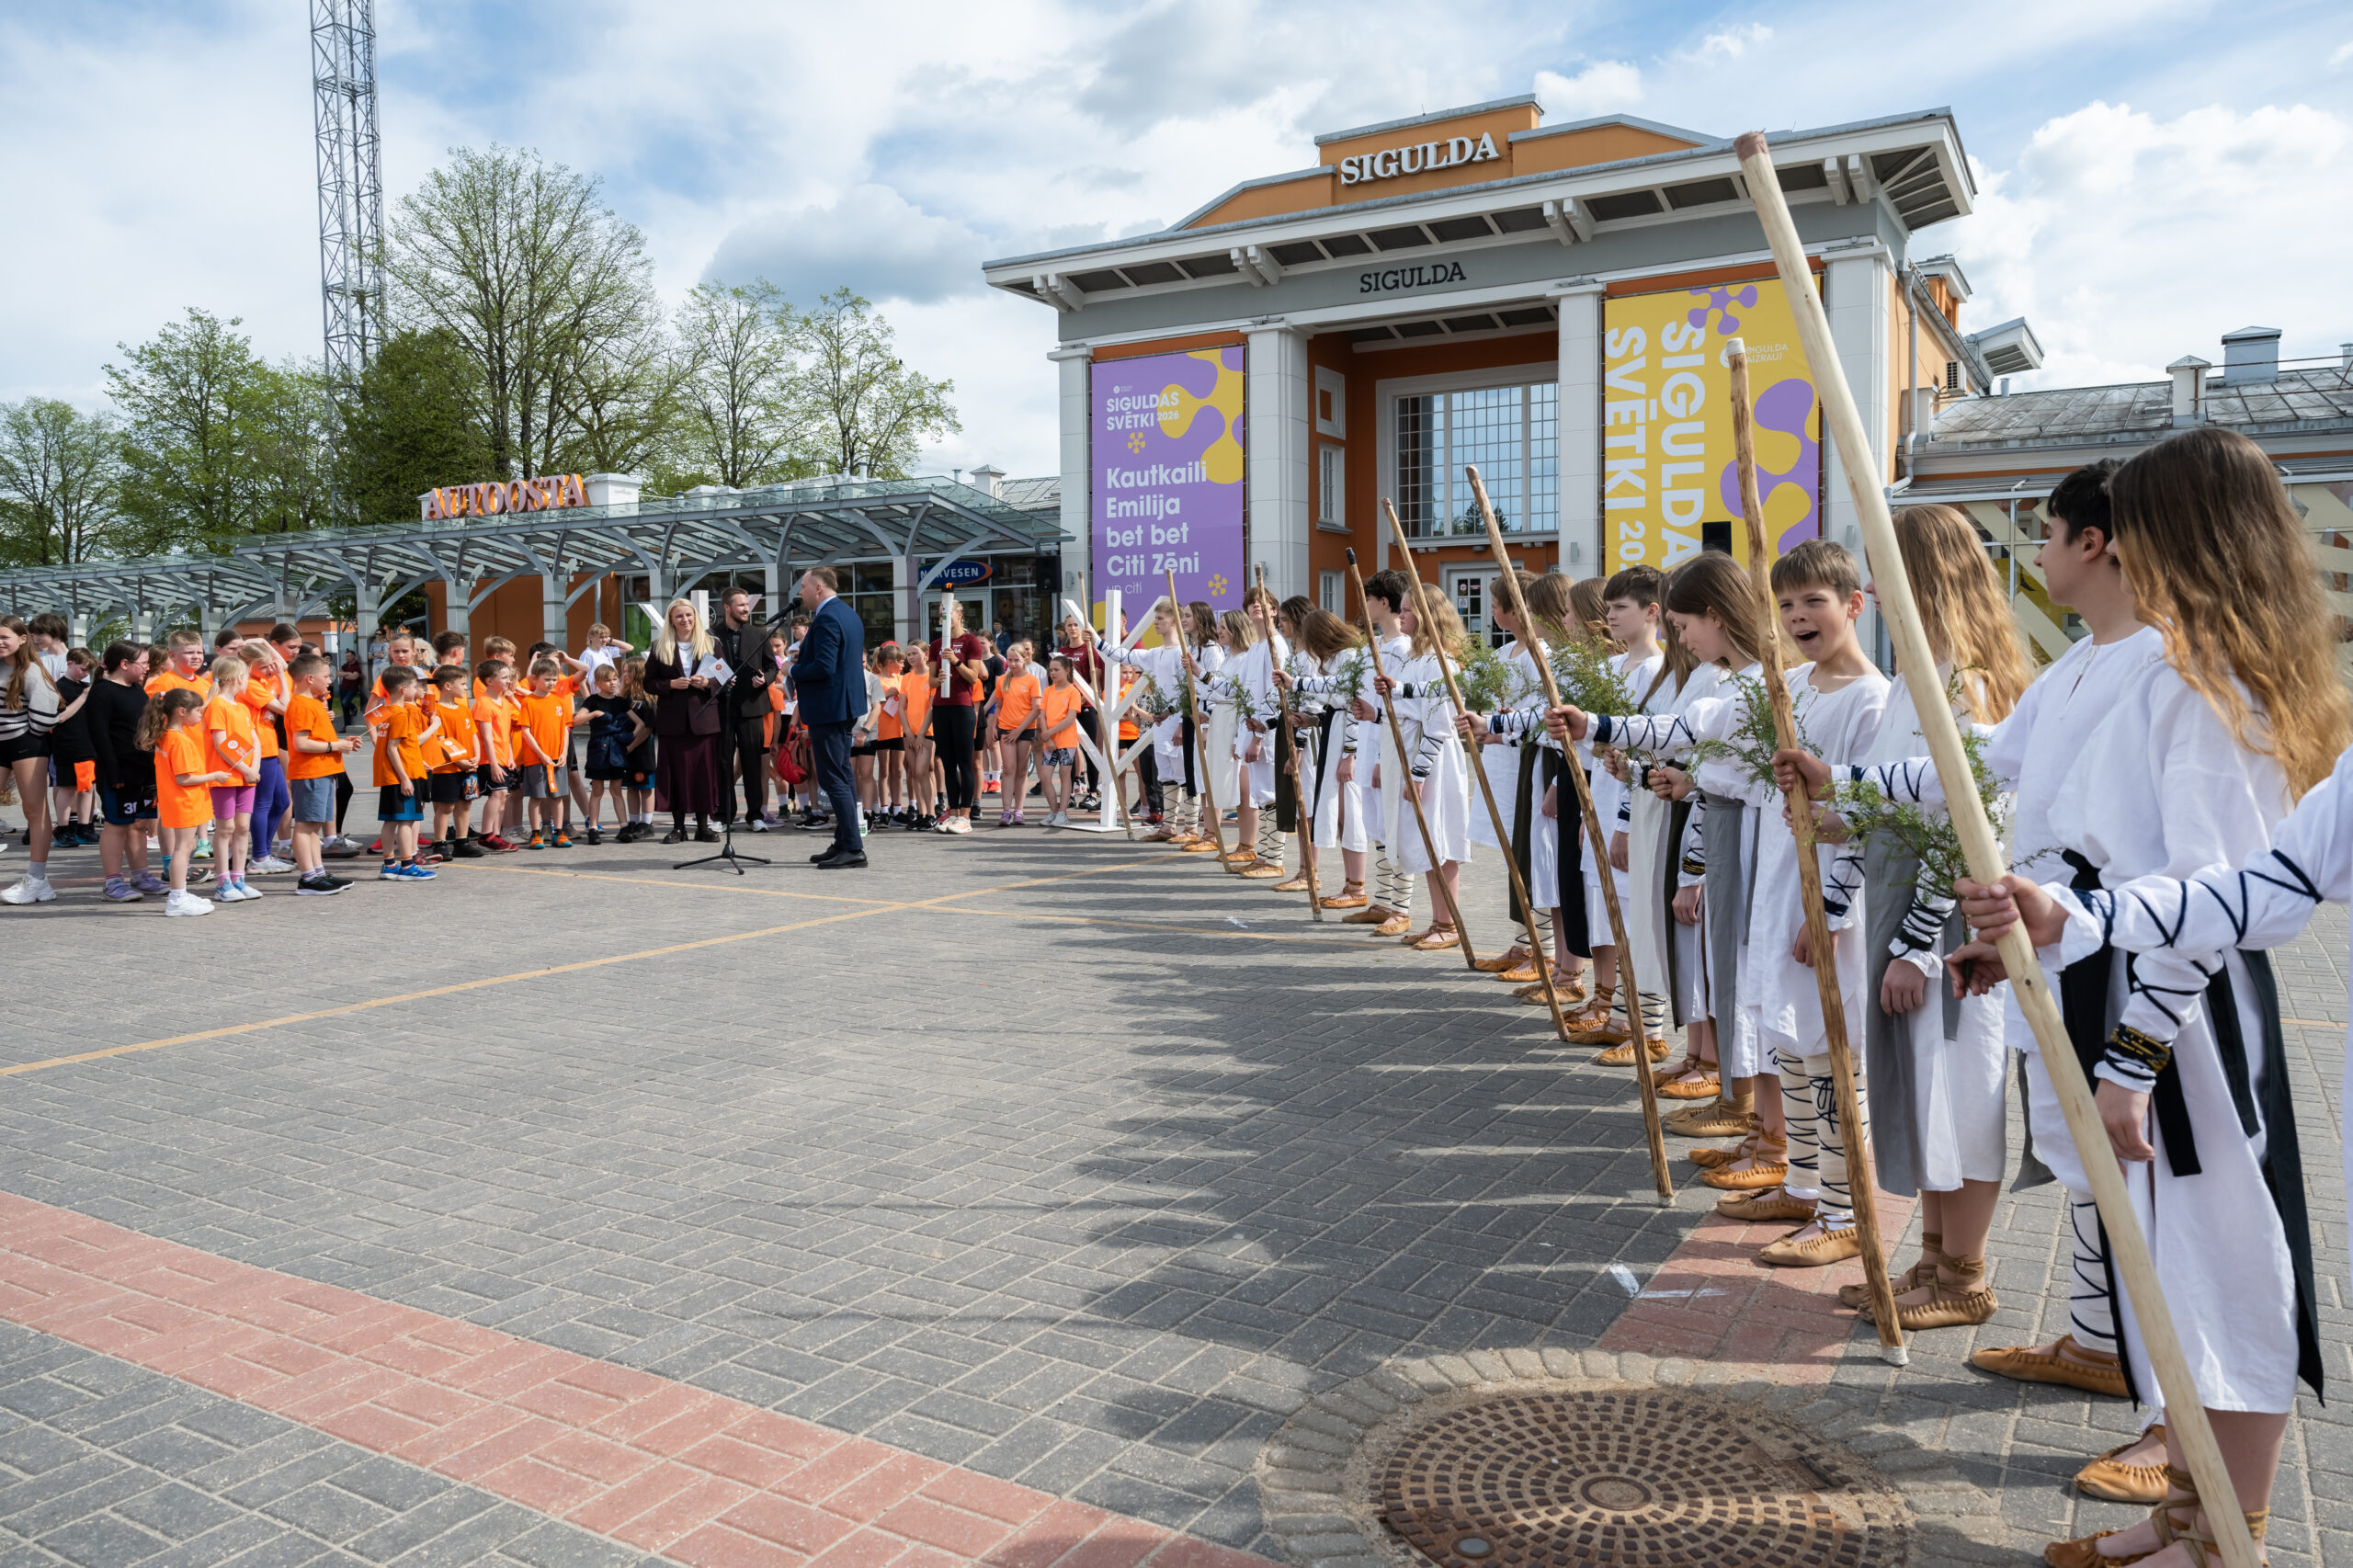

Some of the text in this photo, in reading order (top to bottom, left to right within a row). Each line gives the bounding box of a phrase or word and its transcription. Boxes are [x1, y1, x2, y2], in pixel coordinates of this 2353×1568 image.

[1340, 132, 1500, 185] SIGULDA
[1359, 261, 1467, 293] SIGULDA
[1107, 391, 1180, 413] SIGULDAS
[1107, 410, 1180, 431] SVĒTKI 2026
[1604, 325, 1658, 510] SVĒTKI
[1107, 460, 1207, 489] Kautkaili
[425, 473, 593, 521] AUTOOSTA
[1107, 494, 1181, 521] Emilija
[1107, 522, 1189, 548] bet bet
[920, 567, 979, 579] NVESEN
[1107, 551, 1199, 577] Citi Zēni
[1125, 581, 1142, 595] citi
